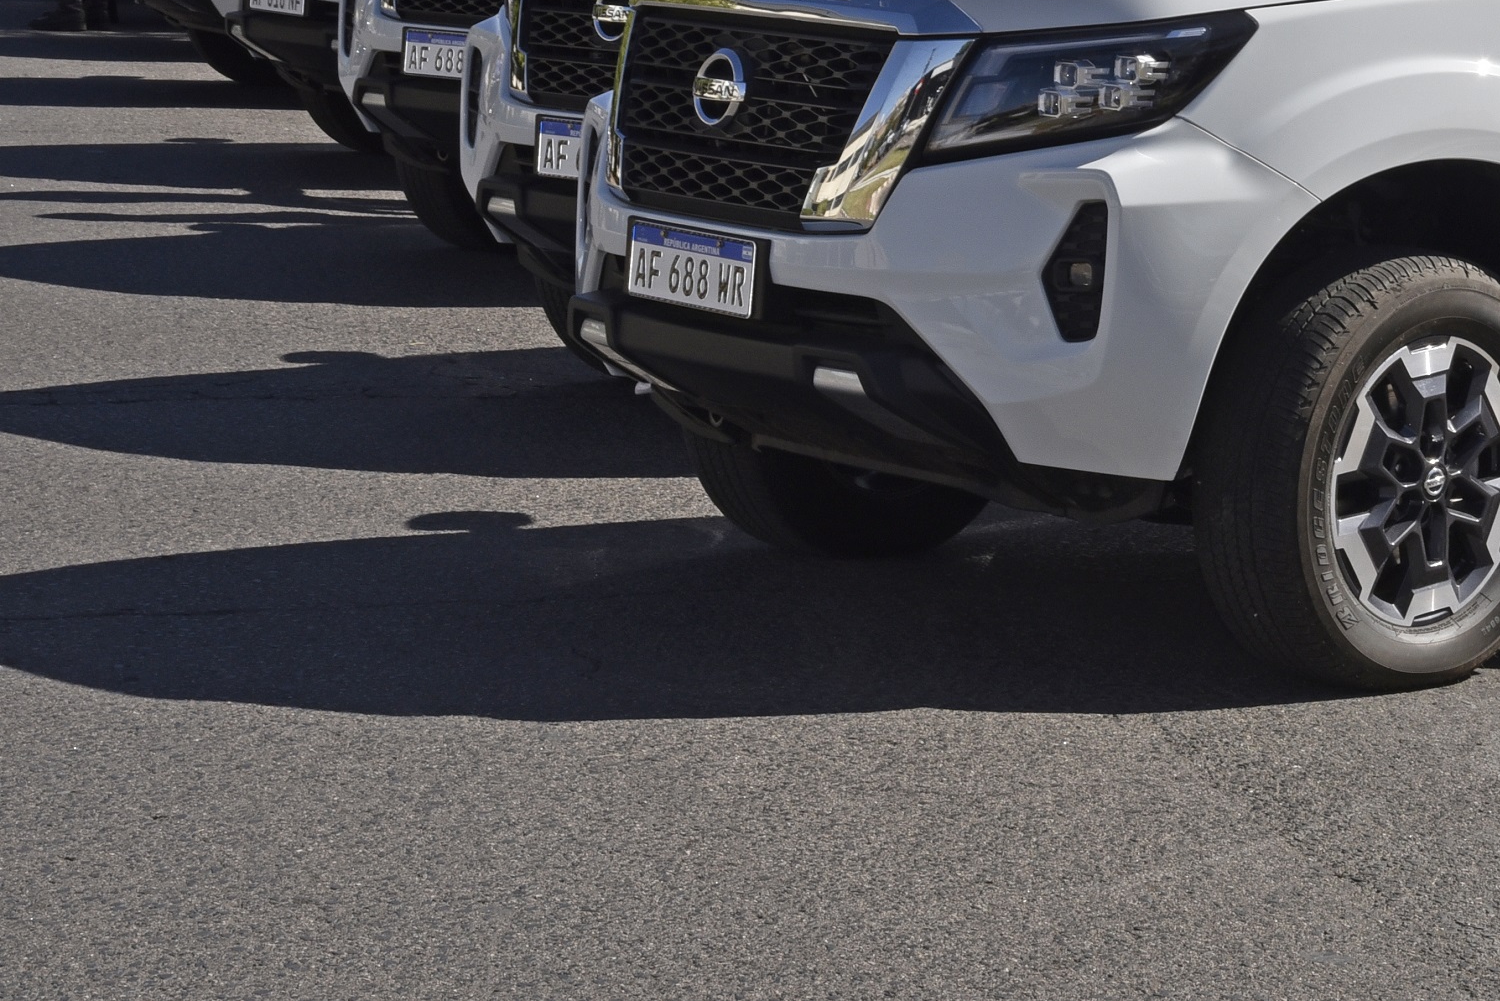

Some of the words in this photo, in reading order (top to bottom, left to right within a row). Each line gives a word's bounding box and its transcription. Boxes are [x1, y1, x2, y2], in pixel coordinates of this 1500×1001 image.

[408, 45, 430, 70] AF
[434, 47, 464, 74] 688
[543, 139, 570, 170] AF
[664, 237, 691, 251] REPÚBLICA
[692, 243, 721, 256] ARGENTINA
[634, 248, 662, 289] AF
[668, 255, 710, 300] 688
